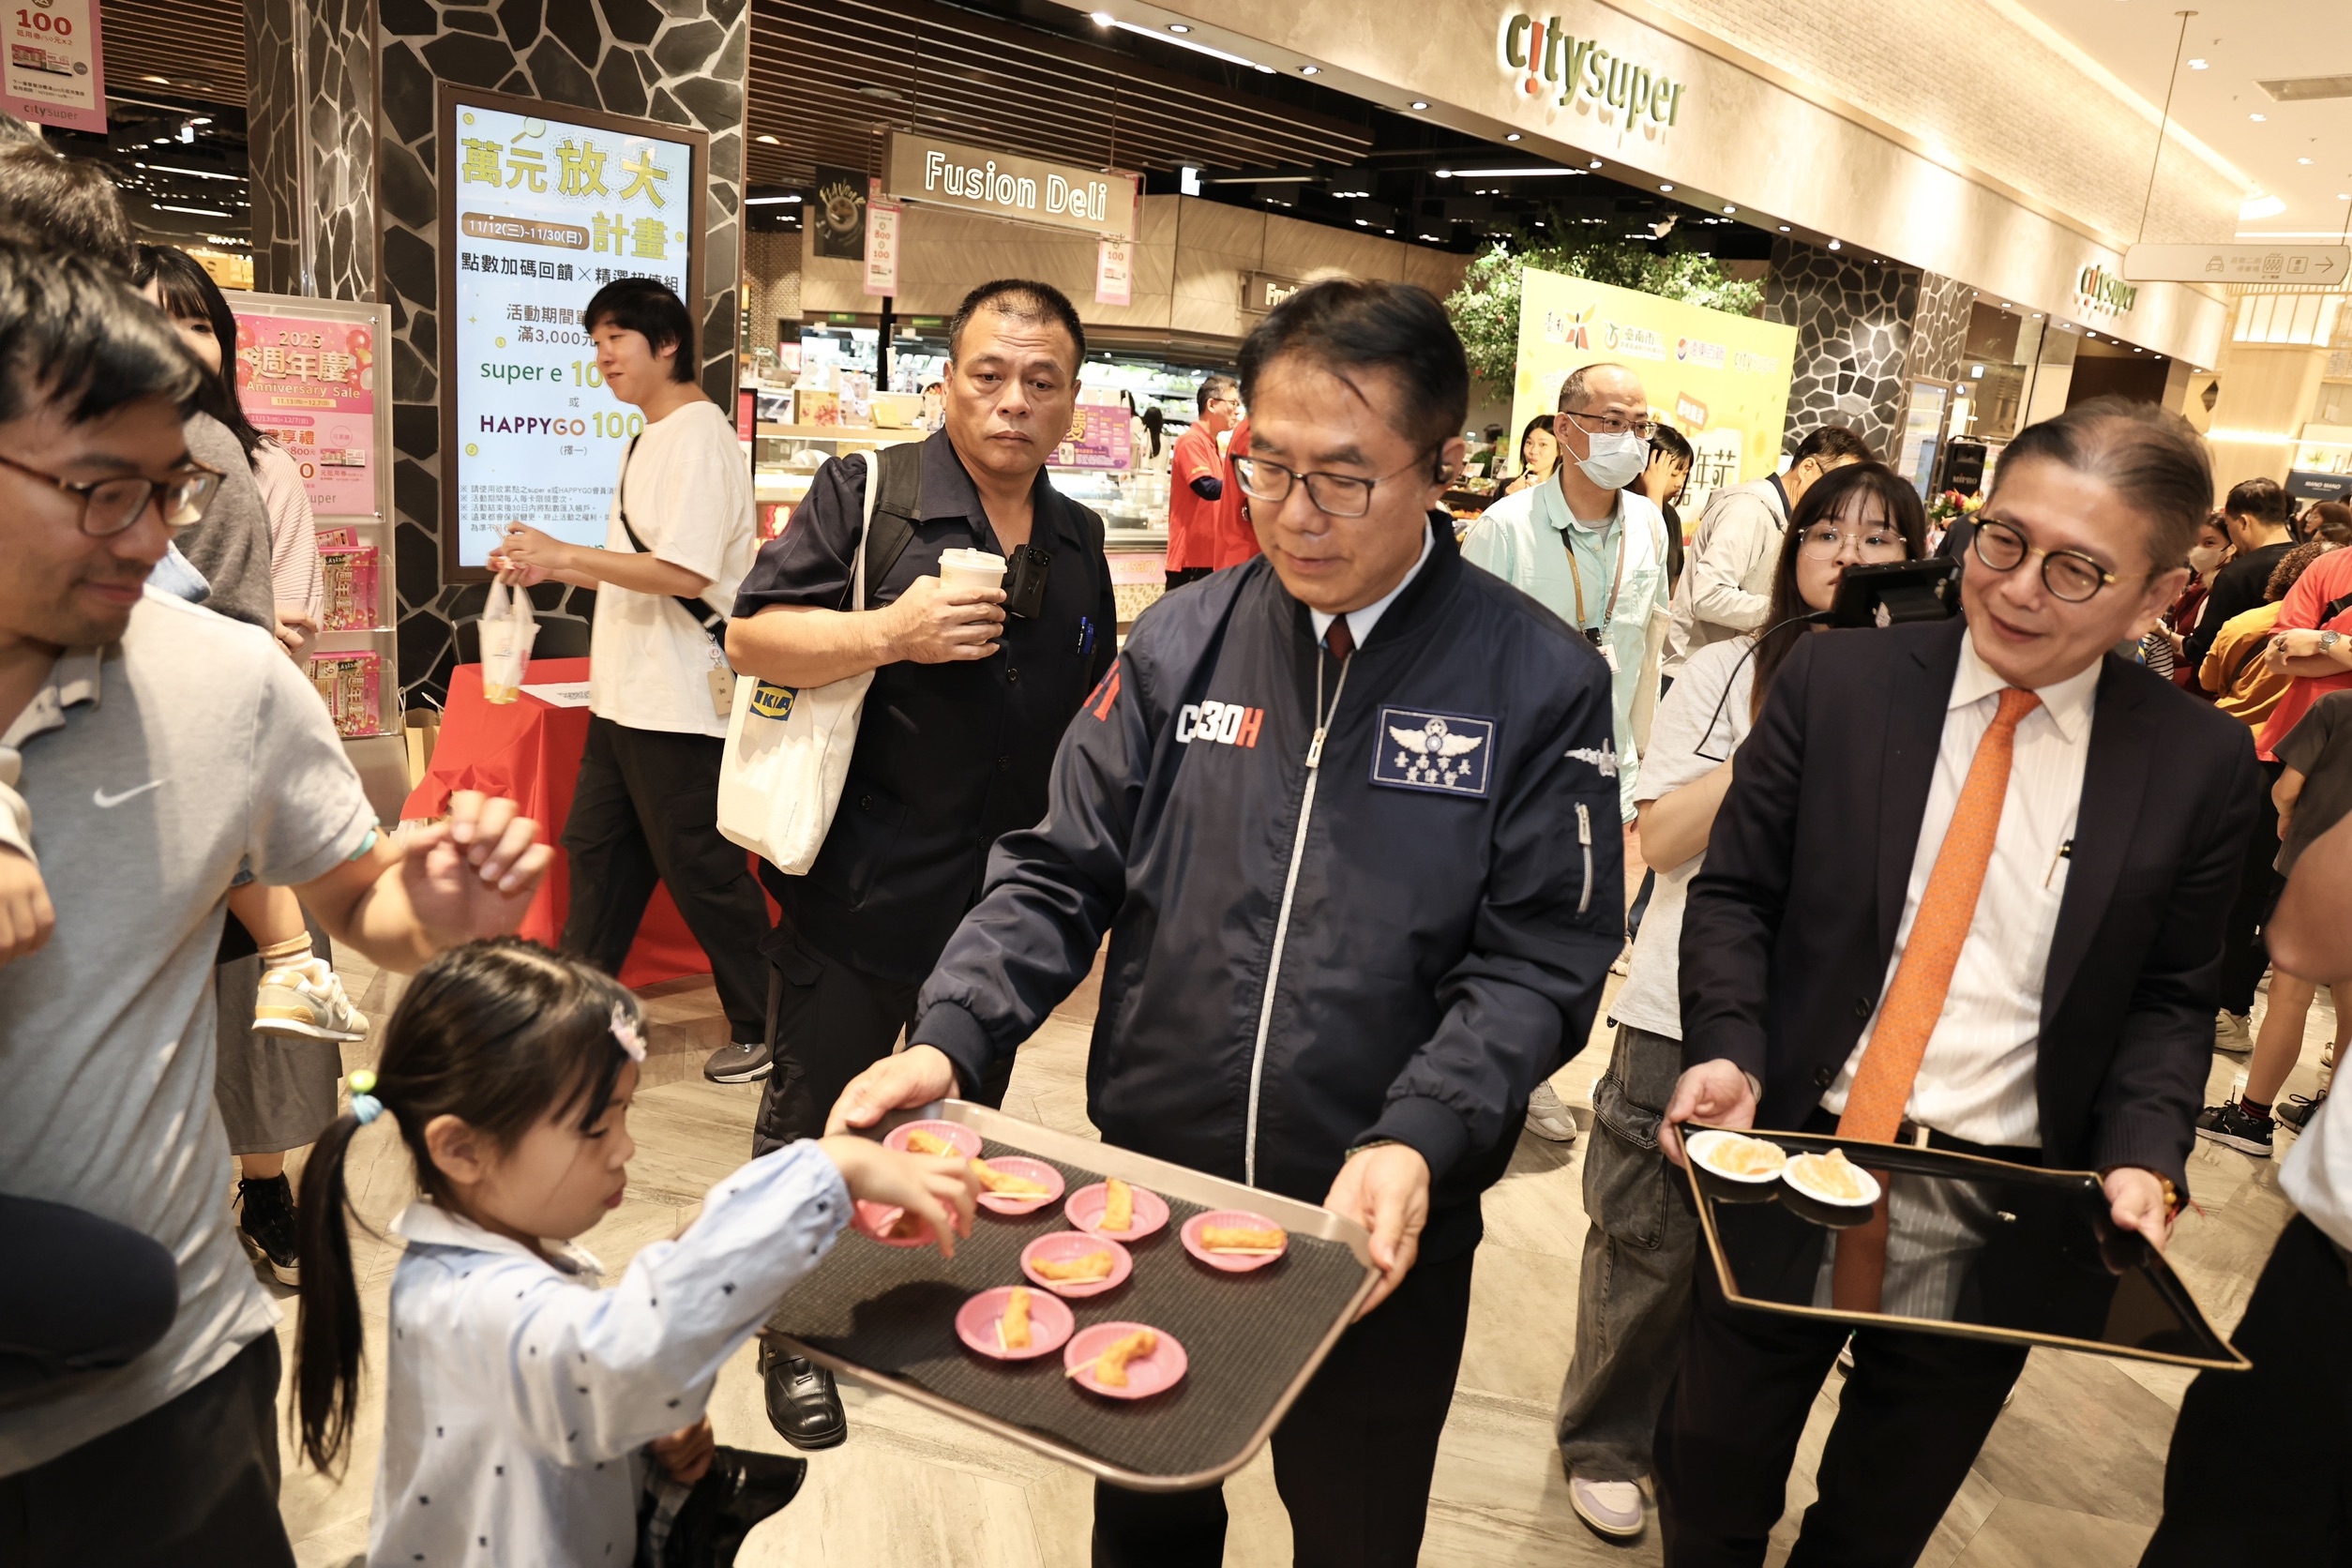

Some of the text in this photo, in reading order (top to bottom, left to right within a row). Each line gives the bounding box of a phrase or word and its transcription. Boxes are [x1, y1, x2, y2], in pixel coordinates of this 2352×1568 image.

[16, 8, 72, 36] 100
[461, 137, 669, 209] 萬元放大
[925, 150, 1108, 221] Fusion Deli
[469, 219, 583, 246] 11/12(三)~11/30(日)
[592, 210, 669, 261] 計畫
[873, 250, 890, 259] 100
[1107, 250, 1124, 261] 100
[279, 330, 323, 349] 2025
[251, 345, 351, 384] 週年慶
[480, 362, 544, 385] super
[550, 367, 563, 383] e
[246, 380, 362, 399] Anniversary Sale
[568, 397, 580, 408] 或
[480, 415, 586, 436] HAPPYGO
[753, 688, 793, 711] IKA
